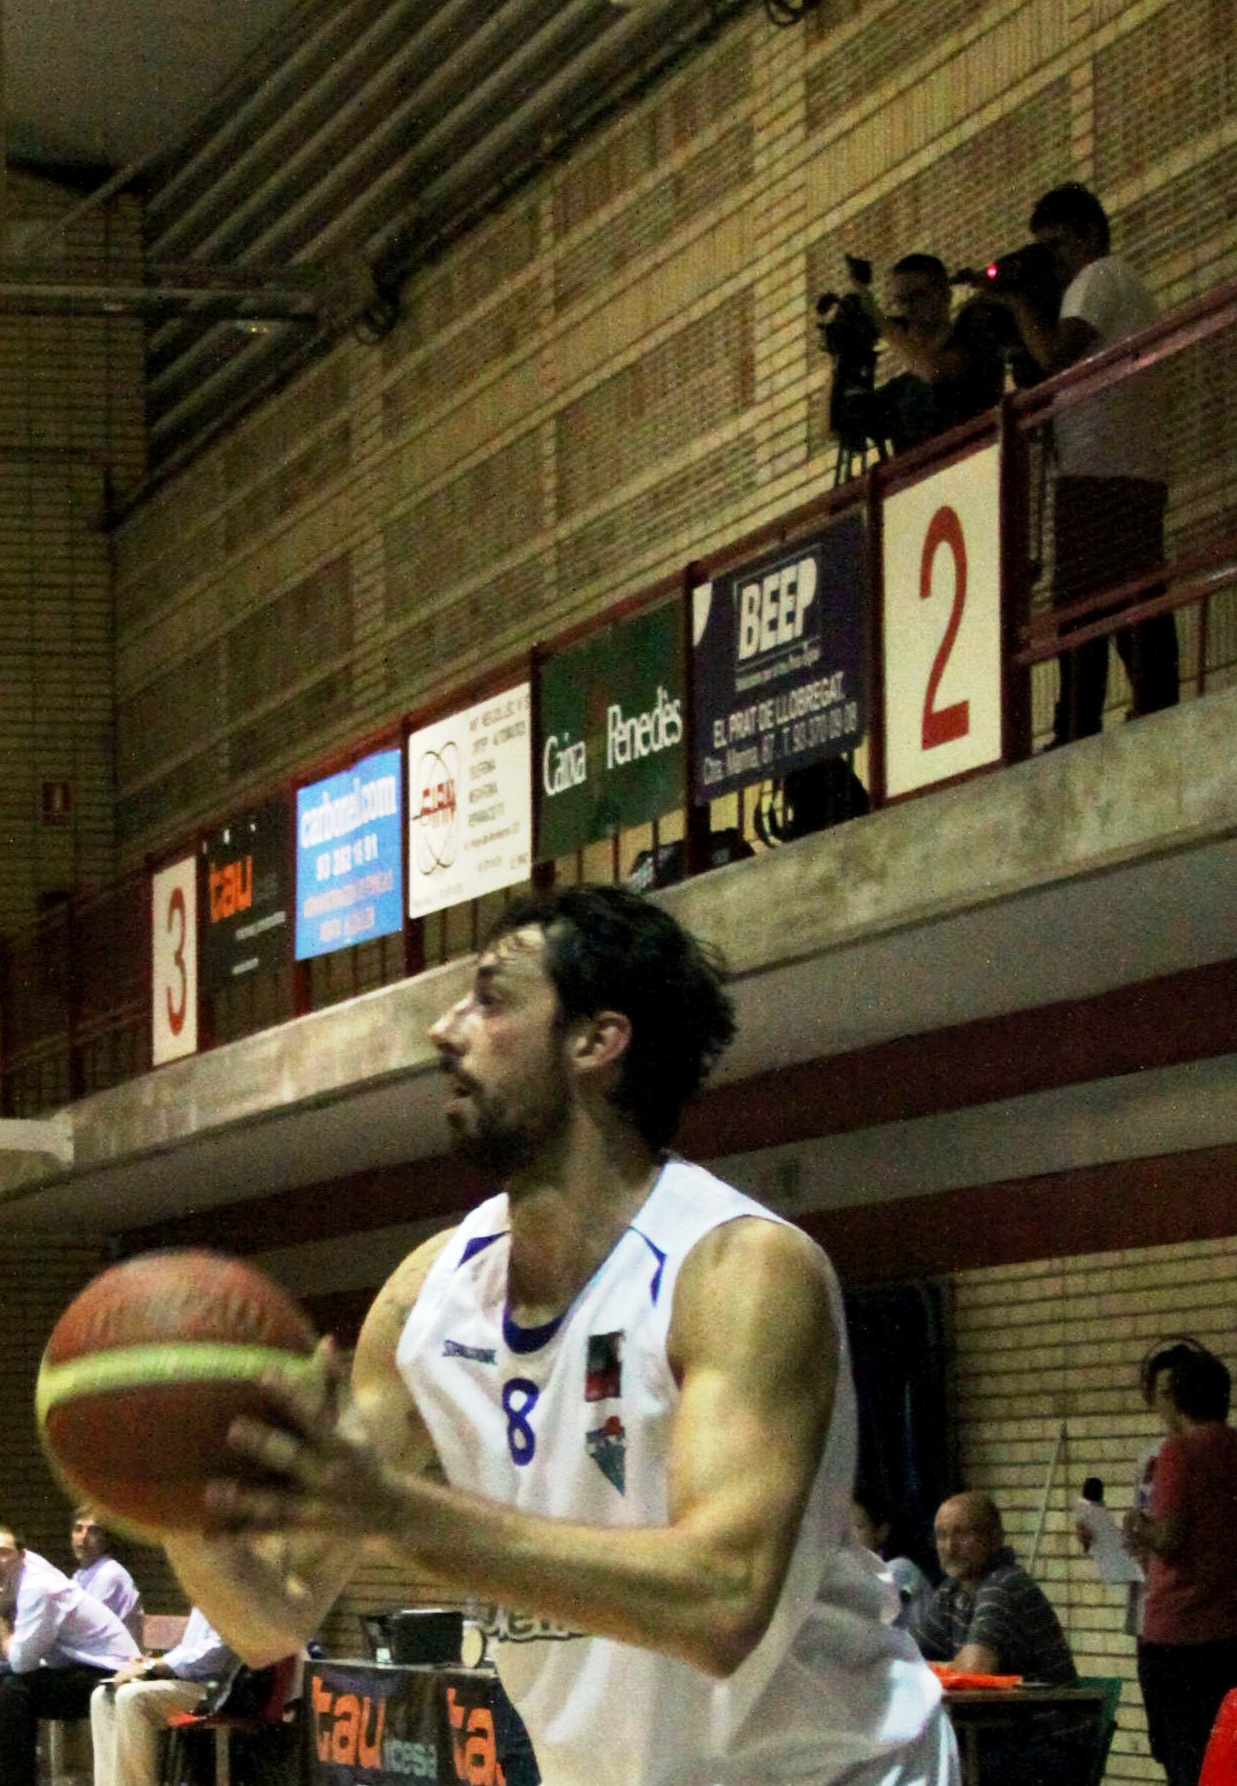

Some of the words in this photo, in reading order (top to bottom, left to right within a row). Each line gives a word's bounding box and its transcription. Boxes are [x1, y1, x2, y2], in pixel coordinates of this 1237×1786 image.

[738, 557, 818, 661] BEEP
[918, 504, 971, 752] 2
[209, 855, 252, 923] tau
[167, 888, 187, 1037] 3
[501, 1377, 540, 1467] 8
[312, 1675, 386, 1770] tau
